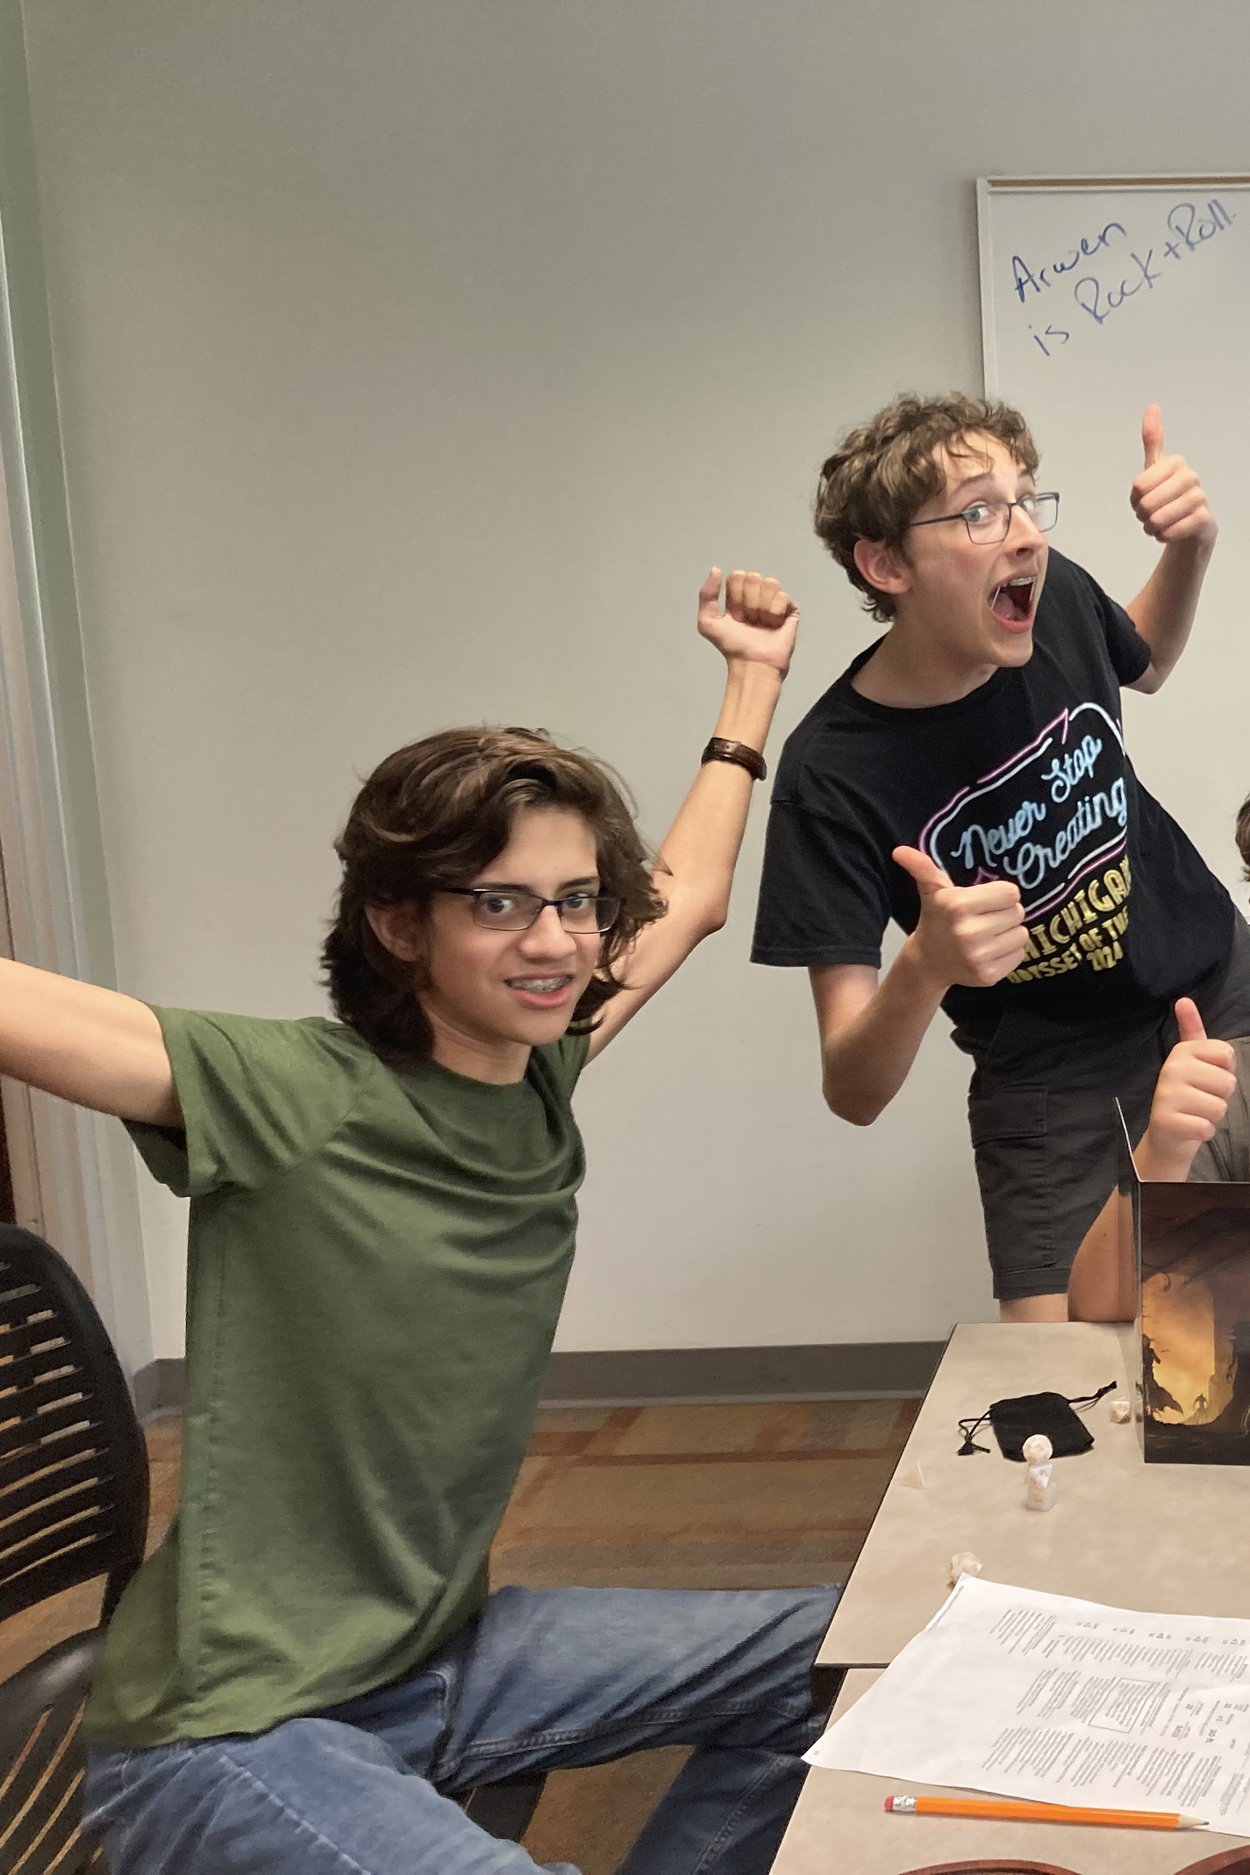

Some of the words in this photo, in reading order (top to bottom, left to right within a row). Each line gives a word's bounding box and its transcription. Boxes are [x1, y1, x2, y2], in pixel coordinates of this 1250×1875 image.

[1012, 222, 1127, 303] Arwen
[1028, 325, 1070, 356] is
[951, 800, 1046, 870] Never
[1041, 734, 1102, 803] Stop
[1003, 777, 1128, 889] Creating
[1078, 927, 1103, 952] OF
